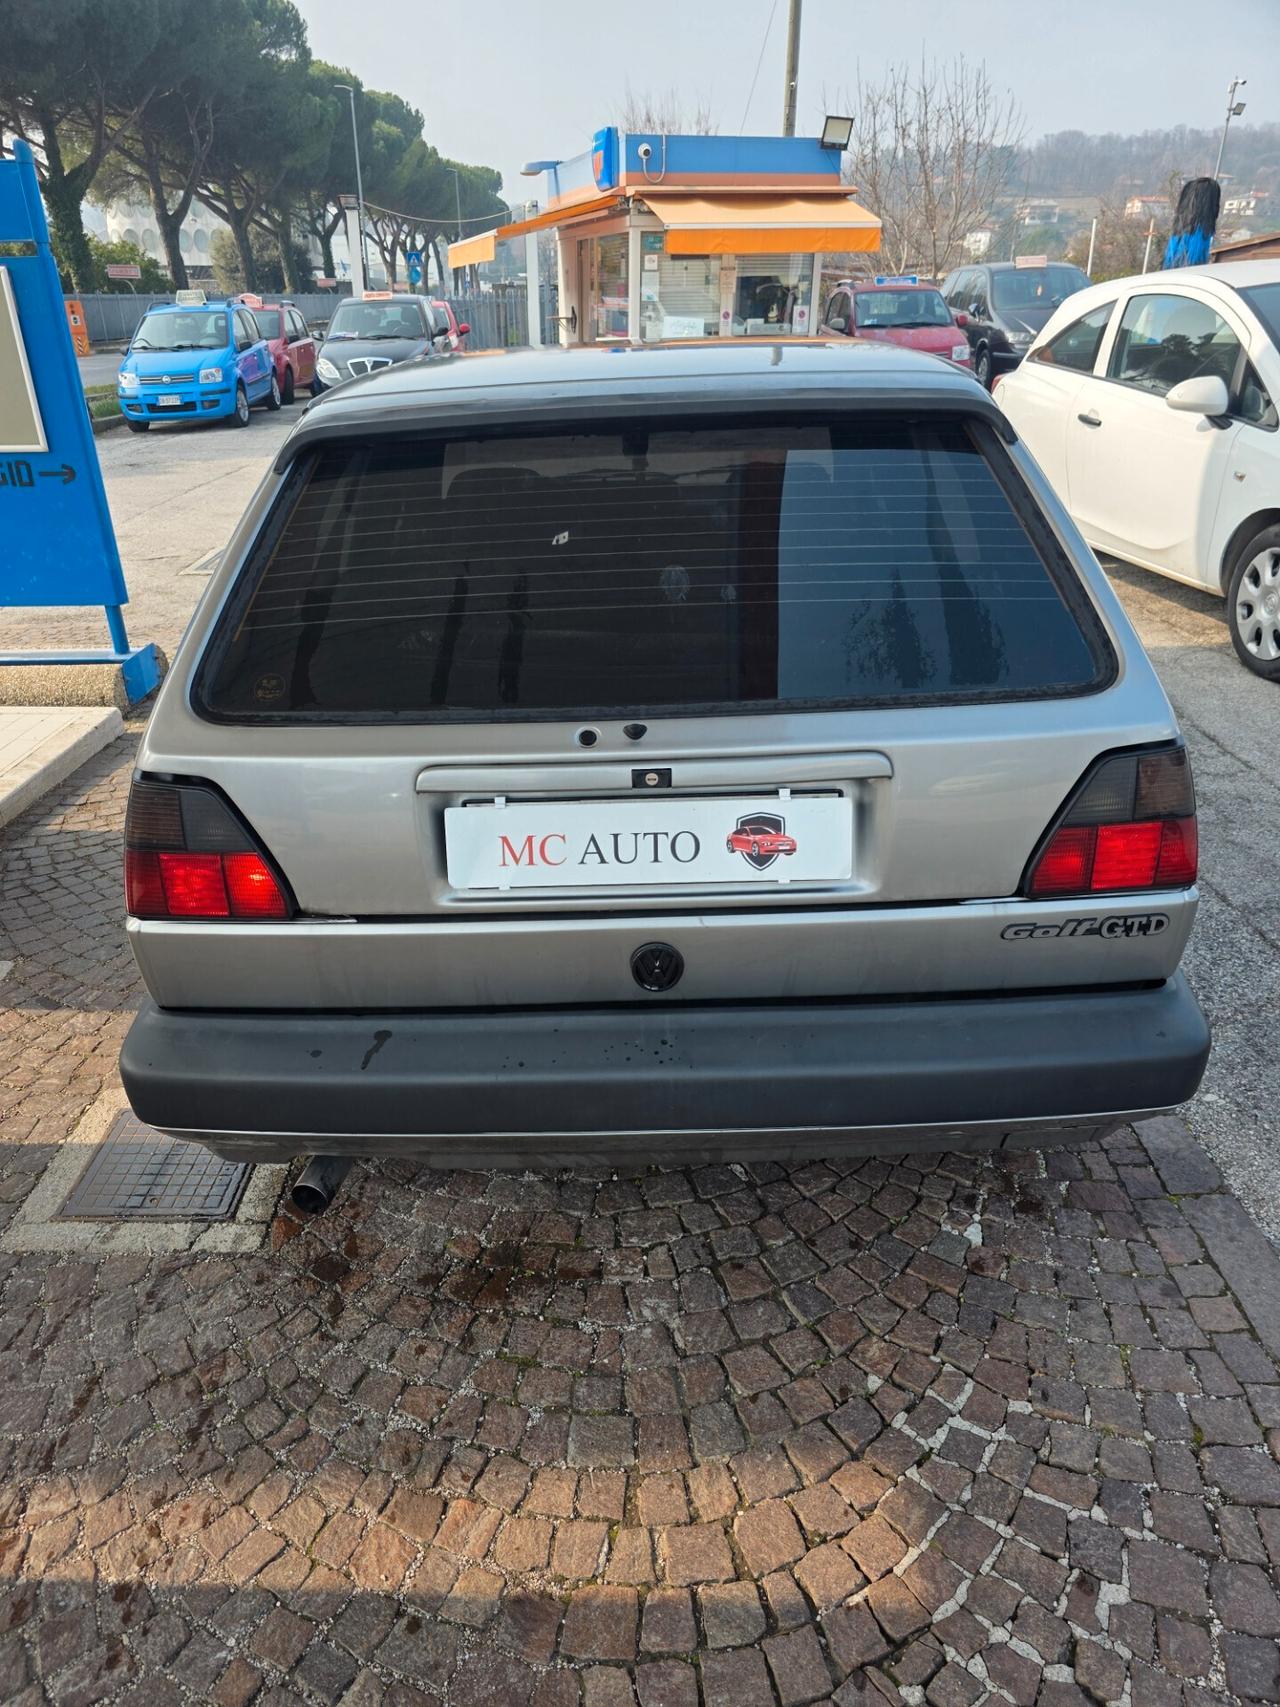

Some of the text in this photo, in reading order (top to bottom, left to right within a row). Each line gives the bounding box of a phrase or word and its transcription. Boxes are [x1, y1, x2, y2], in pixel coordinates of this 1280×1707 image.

[498, 830, 700, 867] MC AUTO
[1001, 912, 1169, 940] Golf GTD
